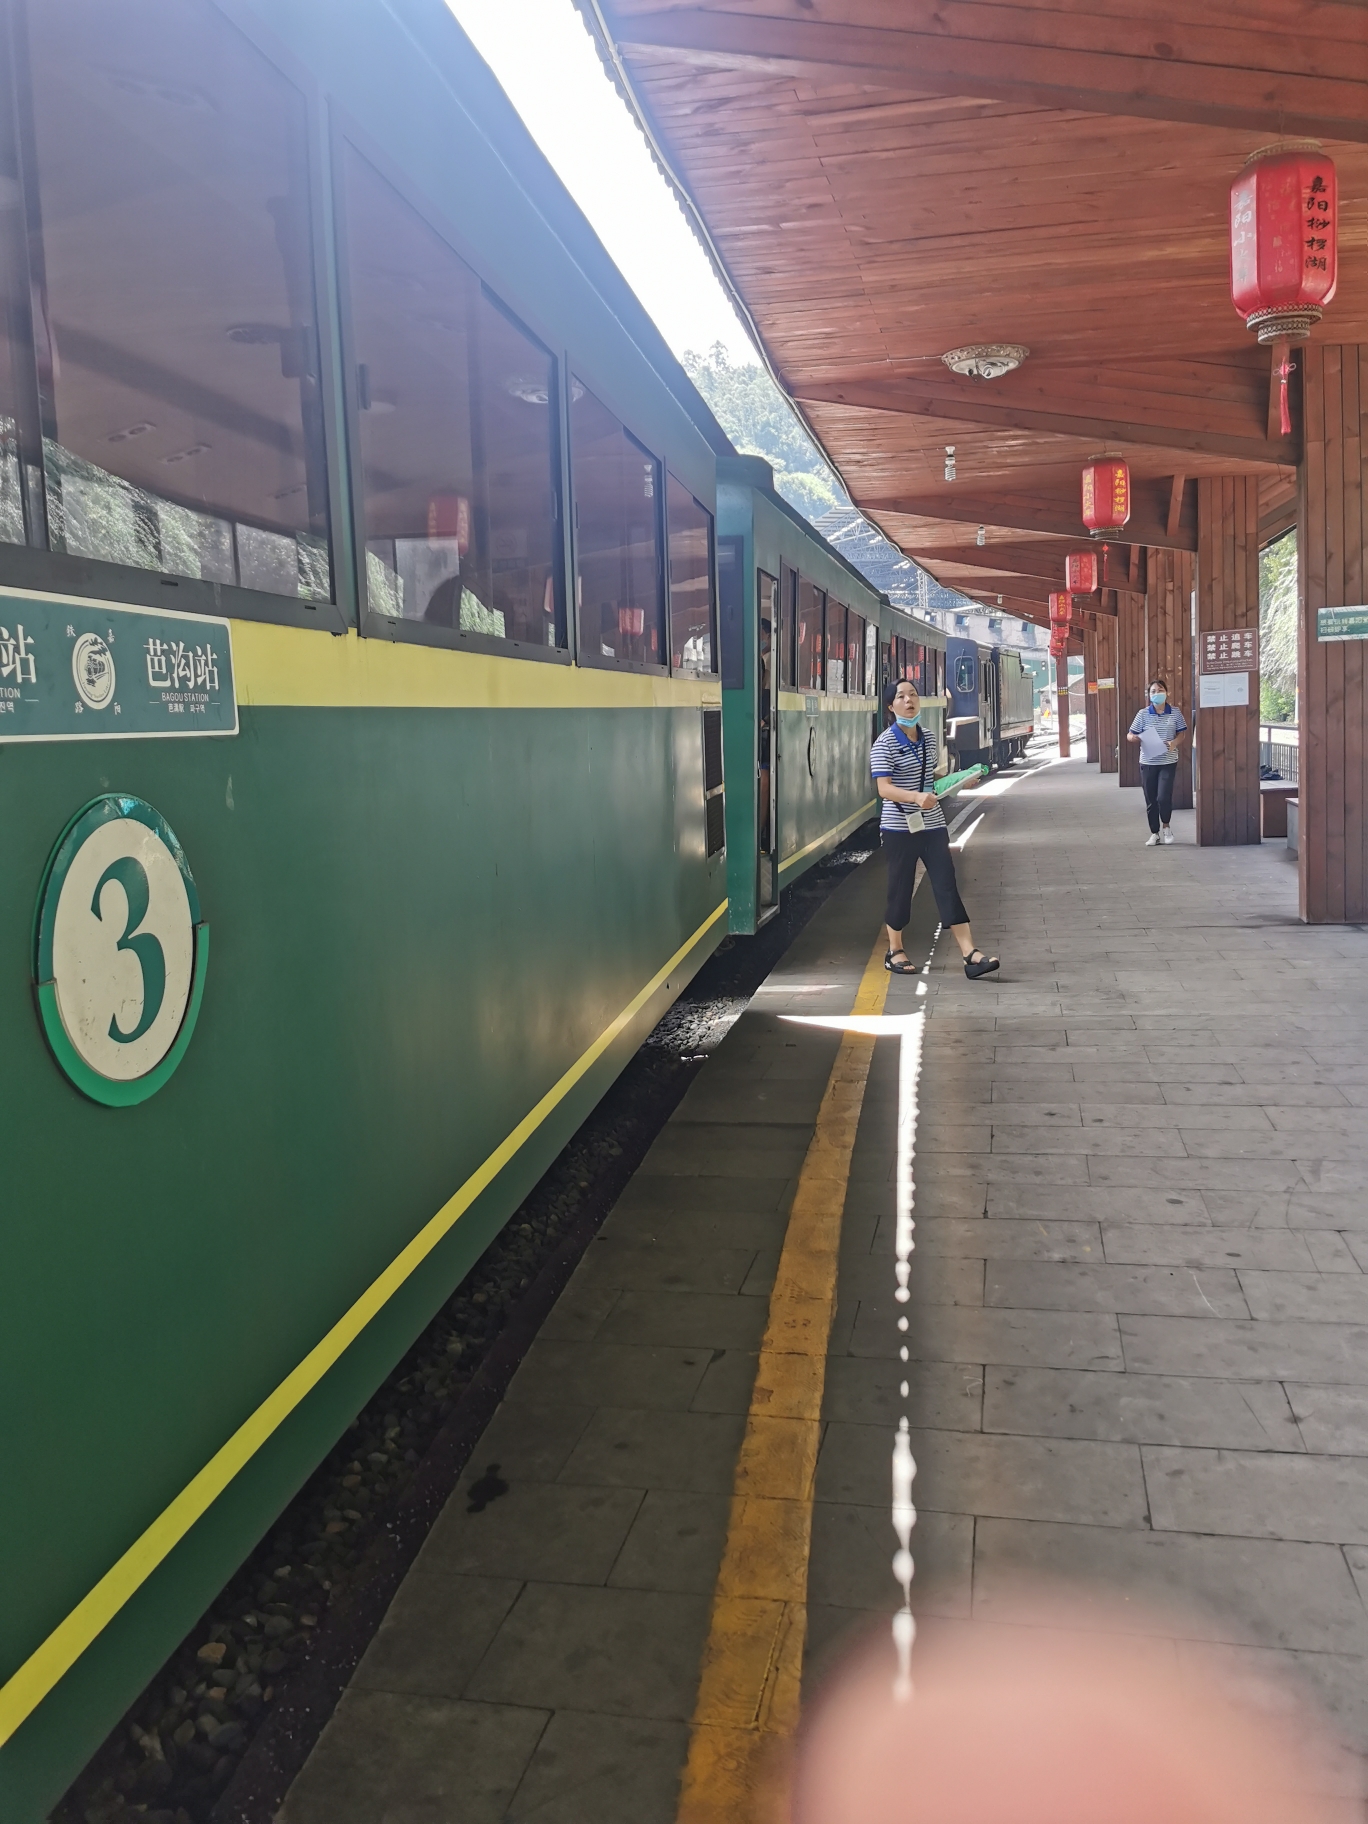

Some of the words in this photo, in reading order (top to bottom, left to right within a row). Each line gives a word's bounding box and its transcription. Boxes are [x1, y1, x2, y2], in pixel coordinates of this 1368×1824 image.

[143, 637, 219, 690] 芭沟站
[184, 693, 209, 702] STATION
[91, 856, 166, 1043] 3
